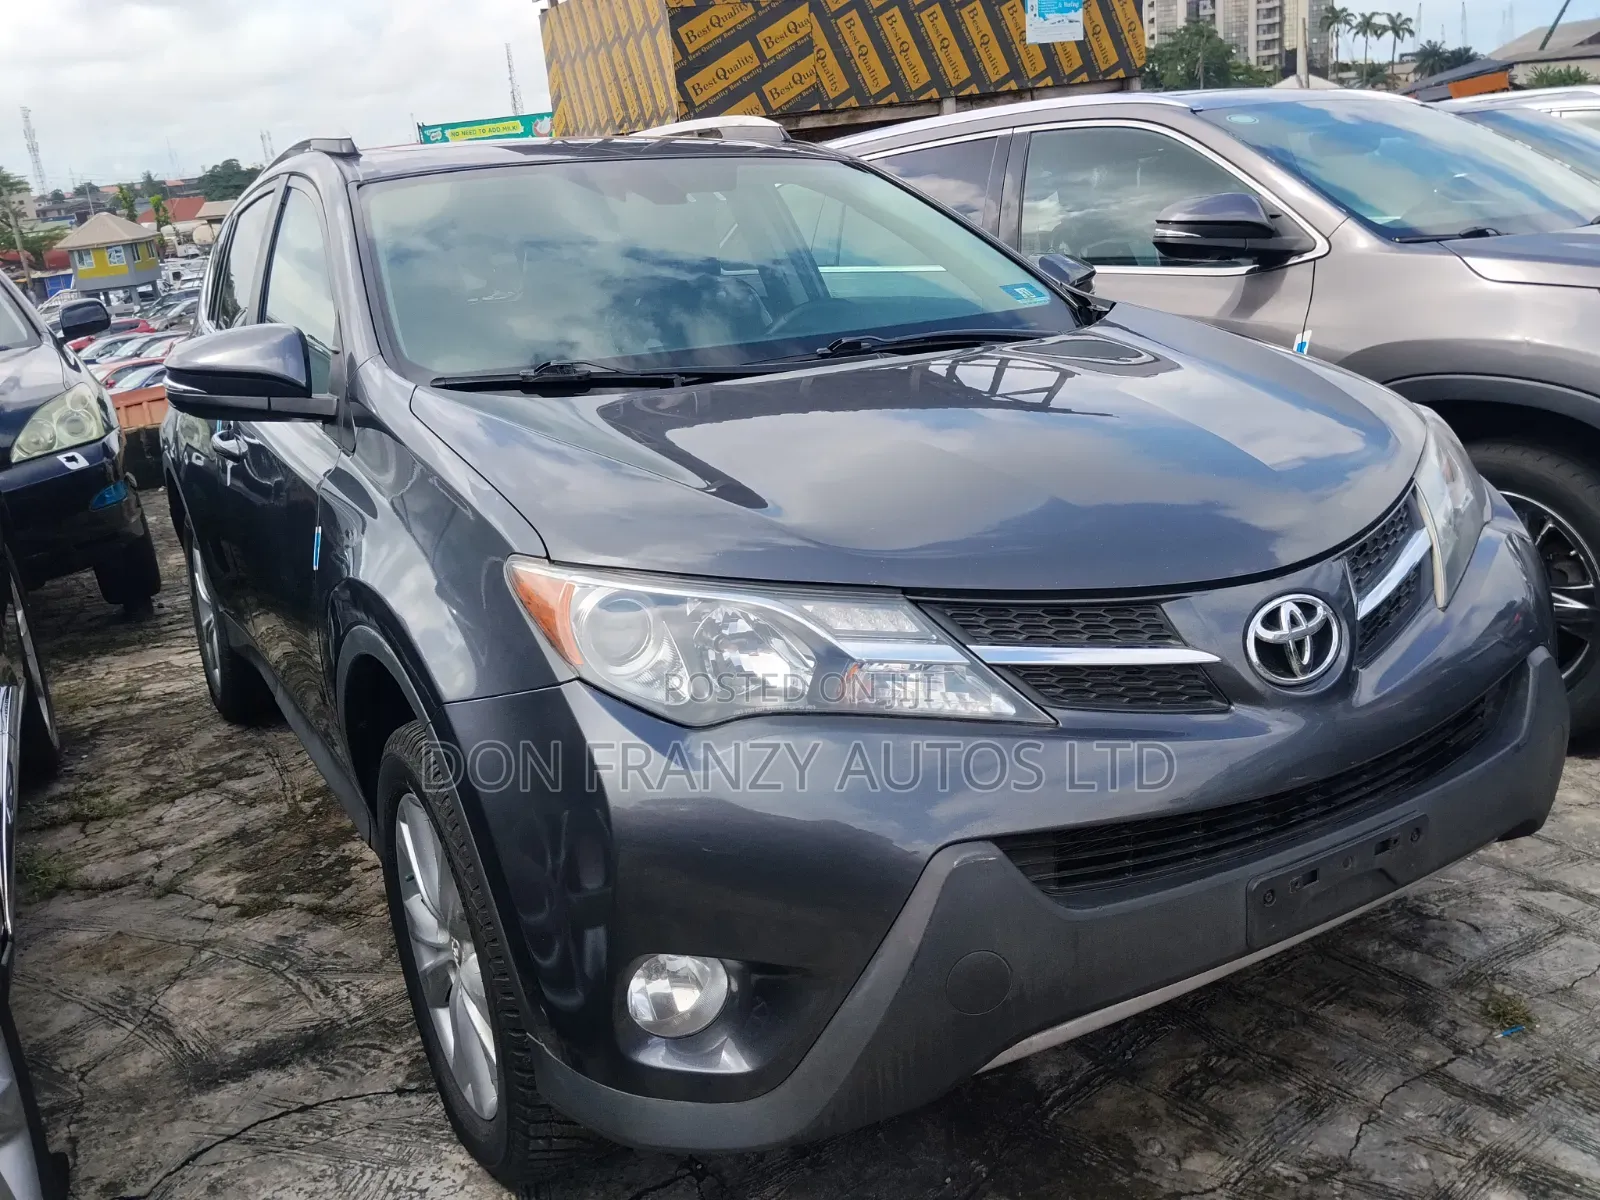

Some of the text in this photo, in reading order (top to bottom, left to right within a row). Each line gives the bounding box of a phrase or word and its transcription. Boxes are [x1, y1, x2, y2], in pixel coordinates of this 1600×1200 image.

[684, 2, 749, 44] Best Quality
[1007, 3, 1022, 32] Best
[762, 31, 788, 50] Best
[843, 17, 881, 88] Best Quality
[885, 13, 922, 84] Best Quality
[927, 9, 962, 80] Best Quality
[967, 6, 1001, 76] Best Quality
[692, 52, 754, 97] Best Quality
[768, 82, 794, 101] Best
[816, 47, 840, 92] Quality
